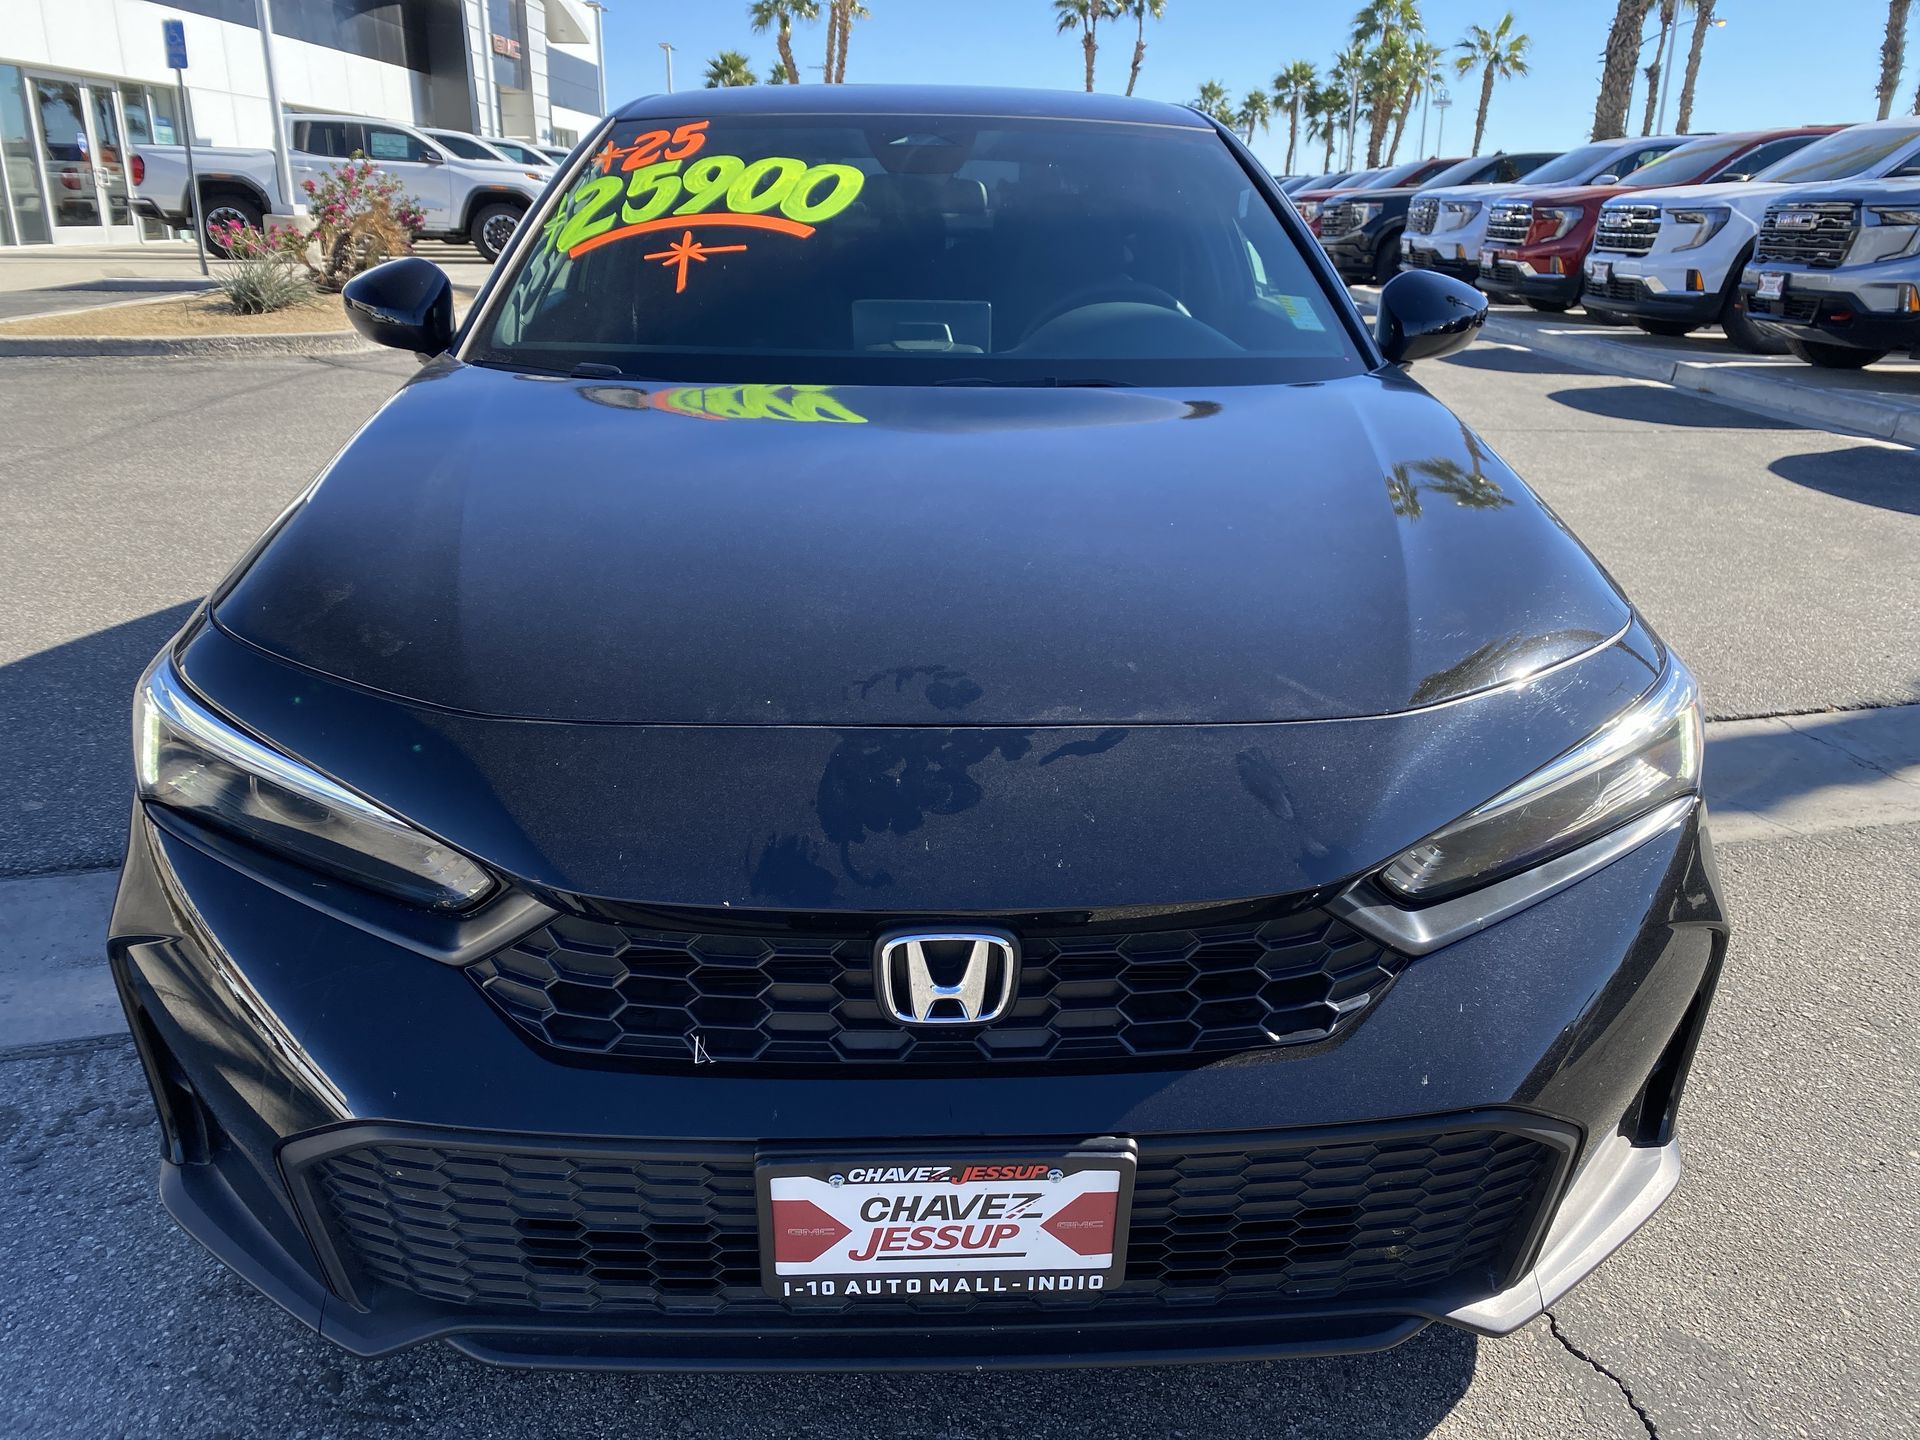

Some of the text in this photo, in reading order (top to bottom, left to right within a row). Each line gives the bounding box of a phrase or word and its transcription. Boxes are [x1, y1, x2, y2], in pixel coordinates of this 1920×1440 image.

[848, 1165, 1049, 1185] CHAVEZ JESSUP
[860, 1193, 1046, 1223] CHAVEZ
[787, 1228, 835, 1236] GMC
[1056, 1220, 1104, 1229] GMC
[848, 1223, 1021, 1262] JESSUP
[783, 1280, 835, 1297] I-10
[844, 1279, 921, 1295] AUTO
